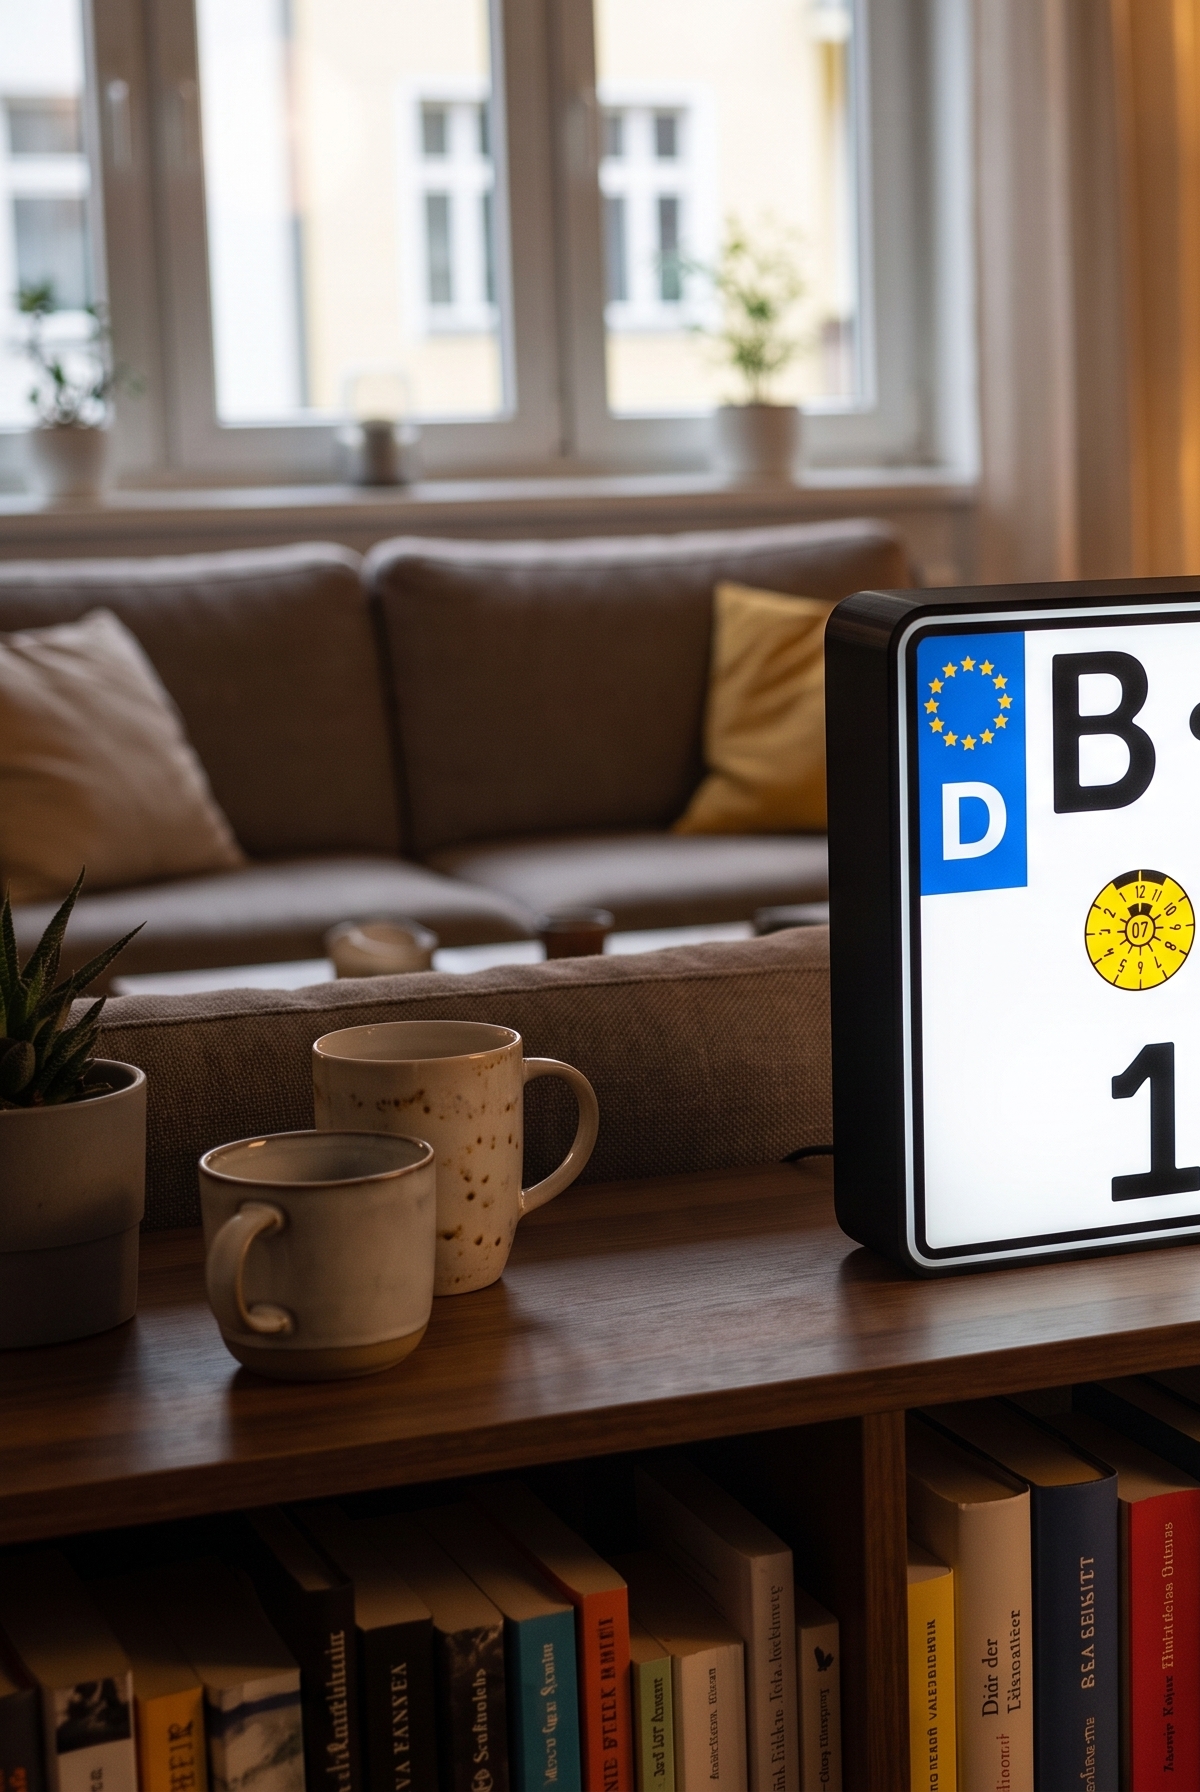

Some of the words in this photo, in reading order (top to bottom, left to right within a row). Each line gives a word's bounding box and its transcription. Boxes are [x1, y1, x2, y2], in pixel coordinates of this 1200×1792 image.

[941, 782, 1007, 861] D
[1119, 892, 1126, 902] 1
[1135, 885, 1145, 898] 12
[1152, 889, 1162, 902] 11
[1104, 908, 1116, 918] 2
[1164, 902, 1176, 916] 10
[1132, 922, 1148, 938] 07
[1165, 941, 1176, 950] 8
[1118, 959, 1127, 973] 5
[981, 1638, 999, 1668] der
